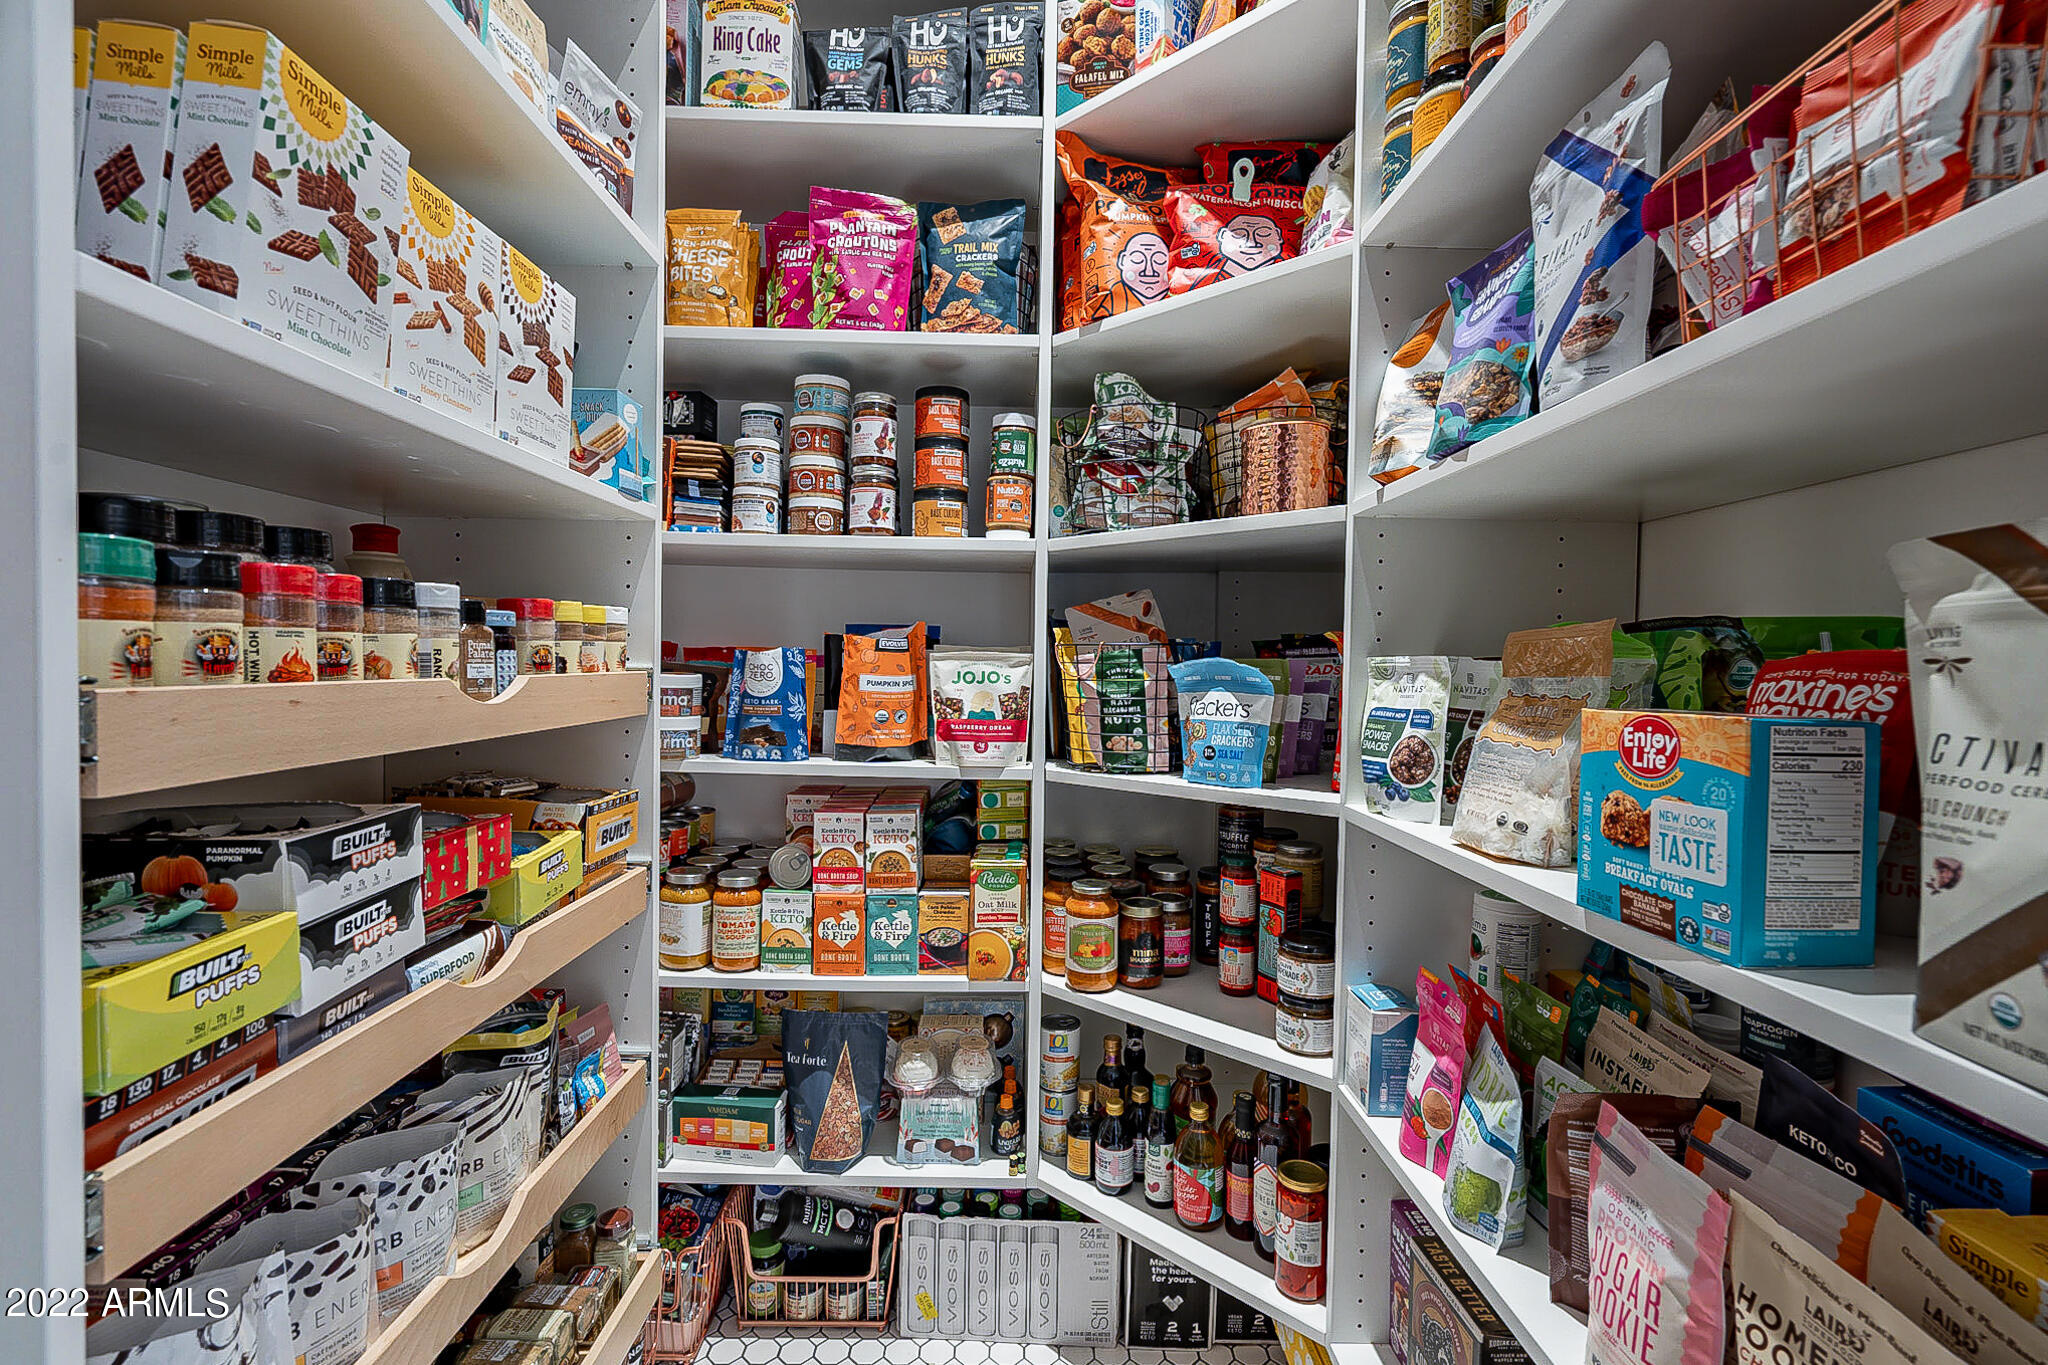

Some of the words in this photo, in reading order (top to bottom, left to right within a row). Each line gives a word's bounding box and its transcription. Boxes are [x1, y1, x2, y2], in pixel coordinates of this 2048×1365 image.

[713, 26, 743, 54] King
[747, 27, 781, 53] Cake
[106, 43, 164, 65] Simple
[197, 44, 255, 66] Simple
[907, 53, 947, 66] HUNKS
[985, 51, 1025, 66] HUNKS
[115, 61, 156, 80] Mills
[205, 61, 246, 80] Mills
[827, 59, 863, 71] GEMS
[1074, 72, 1108, 84] FALAFEL
[1109, 69, 1125, 80] MIX
[287, 60, 342, 115] Simple
[296, 86, 335, 130] Mills
[412, 176, 451, 216] Simple
[1190, 192, 1261, 208] WATERMELON
[1262, 197, 1304, 210] HIBISCU
[829, 220, 898, 237] PLANTAIN
[827, 236, 898, 252] CROUTONS
[953, 243, 979, 254] TRAIL
[981, 242, 999, 253] MIX
[955, 253, 999, 262] CRACKERS
[512, 253, 540, 283] Simple
[670, 266, 713, 283] BITES
[267, 289, 325, 329] SWEET
[329, 317, 370, 351] THINS
[287, 320, 308, 338] Mint
[311, 332, 352, 358] Chocolate
[409, 362, 449, 390] SWEET
[451, 381, 482, 407] THINS
[249, 631, 259, 655] HOT
[433, 648, 442, 678] RANC
[468, 649, 494, 658] Palate
[748, 663, 774, 671] CHOC
[1752, 679, 1899, 713] maxine's
[1213, 723, 1233, 734] FLAX
[1234, 725, 1255, 736] SEED
[1364, 730, 1391, 742] POWER
[1493, 721, 1530, 739] COCONUT
[1773, 728, 1818, 738] Nutrition
[1820, 728, 1848, 738] Facts
[1211, 735, 1254, 749] CRACKERS
[1363, 740, 1389, 752] SNACKS
[1623, 727, 1678, 757] Enjoy
[1218, 750, 1229, 759] SEA
[1230, 750, 1243, 760] SALT
[1632, 748, 1667, 770] Life
[1772, 761, 1812, 771] Calories
[1842, 760, 1863, 771] 230
[1711, 788, 1726, 800] 20
[1659, 810, 1681, 824] NEW
[1684, 815, 1717, 831] LOOK
[340, 828, 385, 853] BUILT
[601, 821, 630, 846] BUILT
[821, 834, 856, 843] KETO
[873, 834, 909, 844] KETO
[1218, 831, 1250, 843] TRUFFLE
[206, 847, 263, 856] PARANORMAL
[206, 855, 243, 864] PUMPKIN
[351, 841, 397, 870] PUFFS
[1659, 832, 1717, 874] TASTE
[981, 872, 1016, 884] Pacific
[1604, 862, 1659, 890] BREAKFAST
[1660, 878, 1694, 900] OVALS
[978, 901, 995, 910] Oat
[996, 901, 1018, 910] Milk
[1621, 888, 1657, 906] CHOCOLATE
[1657, 899, 1674, 911] CHIP
[342, 908, 385, 937] BUILT
[770, 914, 804, 924] KETO
[822, 921, 857, 931] Kettle
[874, 921, 910, 931] Kettle
[1204, 904, 1212, 947] TRUFF
[353, 916, 398, 950] PUFFS
[822, 932, 831, 941] &
[833, 932, 857, 941] Fire
[875, 932, 883, 941] &
[885, 932, 910, 941] Fire
[1132, 949, 1159, 958] mina
[178, 949, 246, 992] BUILT
[419, 951, 476, 987] SUPERFOOD
[196, 965, 262, 1010] PUFFS
[324, 991, 367, 1028] BUILT
[245, 1017, 265, 1035] 100
[1743, 1015, 1799, 1039] ADAPTOGEN
[508, 1051, 549, 1064] BUILT
[787, 1051, 801, 1064] Tea
[162, 1064, 175, 1080] 17
[128, 1077, 154, 1097] 130
[100, 1098, 118, 1113] 18
[129, 1116, 152, 1132] 100%
[153, 1104, 175, 1120] REAL
[175, 1077, 222, 1105] CHOCOLATE
[817, 1211, 828, 1234] MCT
[1608, 1202, 1656, 1253] ORGANIC
[1080, 1227, 1096, 1240] 24
[1599, 1207, 1667, 1284] PROTEIN
[141, 1254, 175, 1276] 140
[1152, 1266, 1167, 1275] the
[1948, 1235, 2029, 1299] Simple
[1152, 1274, 1166, 1283] for
[1167, 1276, 1197, 1285] yours.
[1424, 1242, 1459, 1276] TASTE
[1452, 1276, 1497, 1323] BETTER
[1591, 1226, 1661, 1327] SUGAR
[1090, 1300, 1110, 1331] Still
[1594, 1275, 1659, 1365] OOKIE
[1805, 1296, 1866, 1353] LAIRD
[1924, 1298, 1980, 1356] LAIRD
